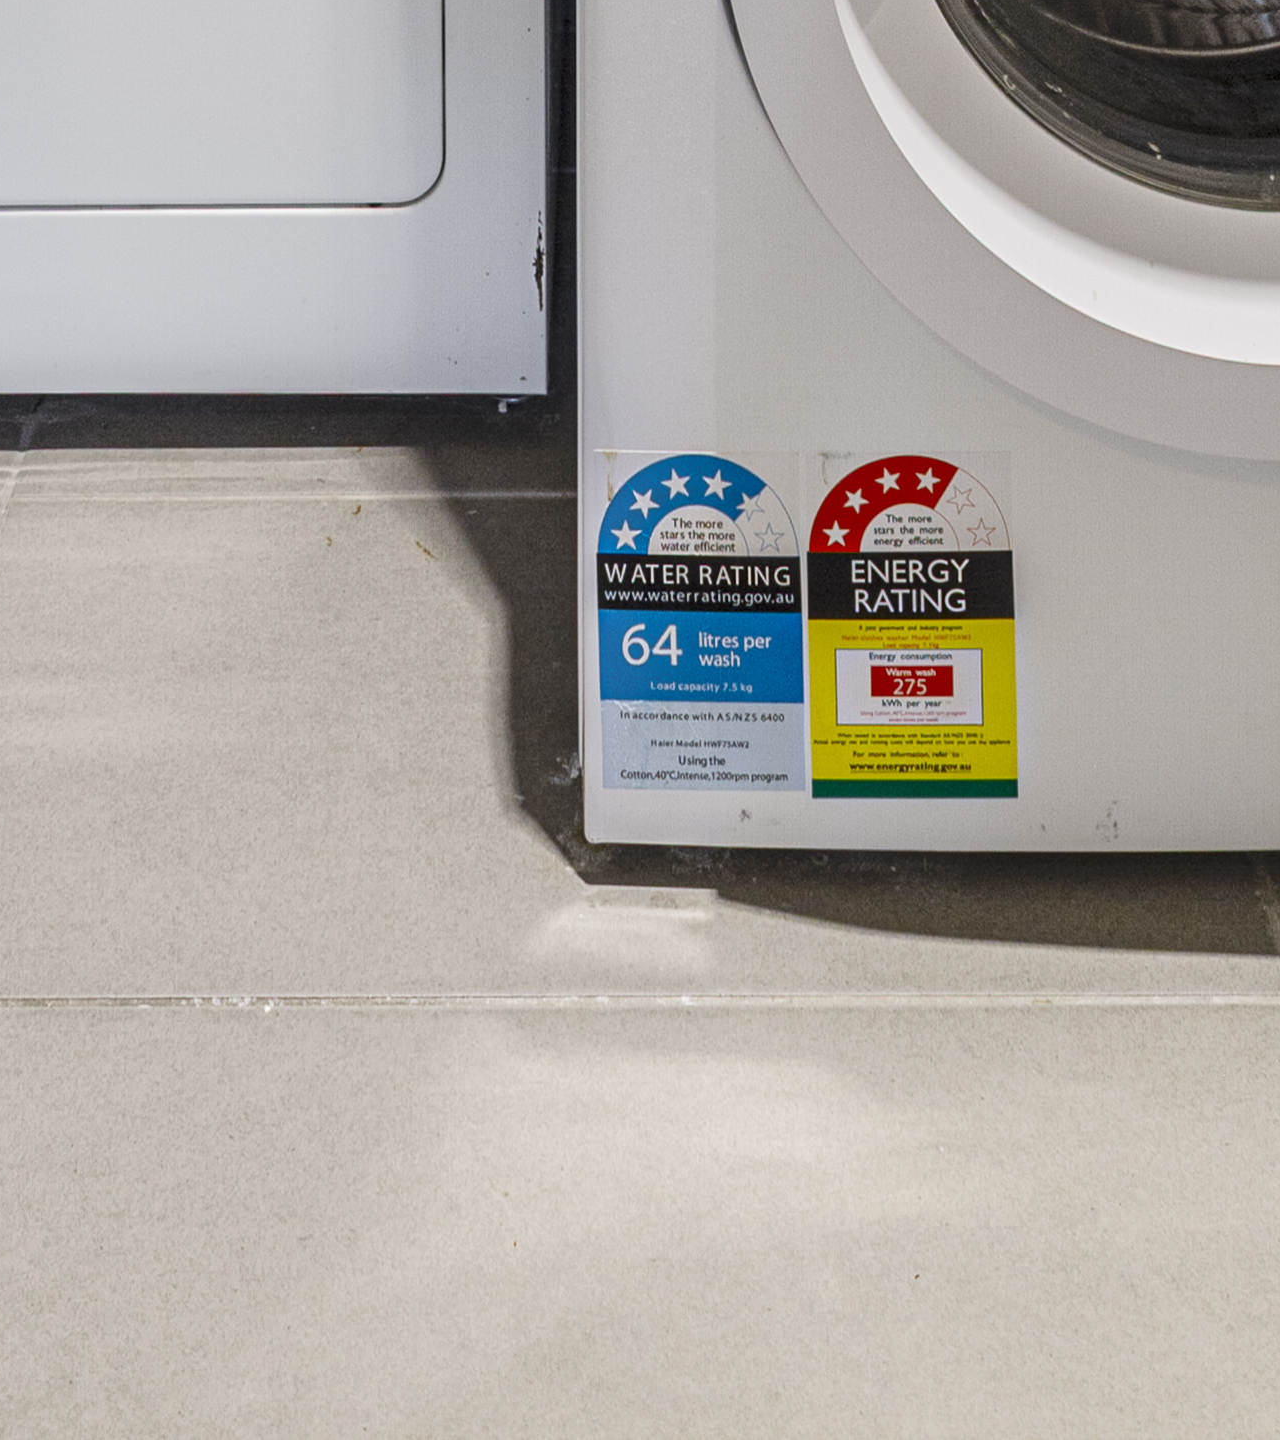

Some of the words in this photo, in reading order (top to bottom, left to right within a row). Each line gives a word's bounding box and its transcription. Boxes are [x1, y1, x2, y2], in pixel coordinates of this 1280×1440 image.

[672, 518, 692, 529] The
[696, 520, 723, 529] more
[886, 514, 903, 523] The
[908, 515, 932, 524] more
[659, 531, 685, 540] stars
[688, 531, 705, 540] the
[708, 533, 735, 541] more
[873, 526, 895, 535] stars
[899, 526, 915, 535] the
[661, 543, 690, 552] water
[694, 542, 735, 552] efficient
[874, 538, 904, 547] energy
[908, 536, 944, 545] efficient
[604, 563, 689, 584] WATER
[699, 565, 791, 587] RATING
[851, 558, 970, 584] ENERGY
[604, 589, 795, 606] www.waterrating.gov.au
[854, 588, 967, 613] RATING
[622, 623, 683, 666] 64
[698, 632, 739, 649] litres
[743, 636, 772, 652] per
[698, 650, 741, 667] wash
[869, 652, 896, 662] Energy
[900, 652, 953, 661] consumption
[885, 668, 911, 676] Warm
[915, 668, 936, 676] wash
[650, 681, 676, 691] Load
[678, 682, 720, 693] capacity
[740, 683, 753, 694] kg
[893, 678, 927, 696] 275
[882, 699, 902, 707] kWh
[906, 701, 920, 709] per
[924, 701, 942, 709] year
[620, 711, 630, 719] In
[632, 711, 690, 721] accordance
[692, 712, 714, 721] with
[760, 713, 785, 723] 6400
[650, 739, 673, 747] Haier
[676, 740, 702, 748] Model
[678, 755, 708, 767] Using
[709, 755, 726, 766] the
[849, 762, 971, 772] www.energyrating.gov.au
[751, 772, 788, 783] program
